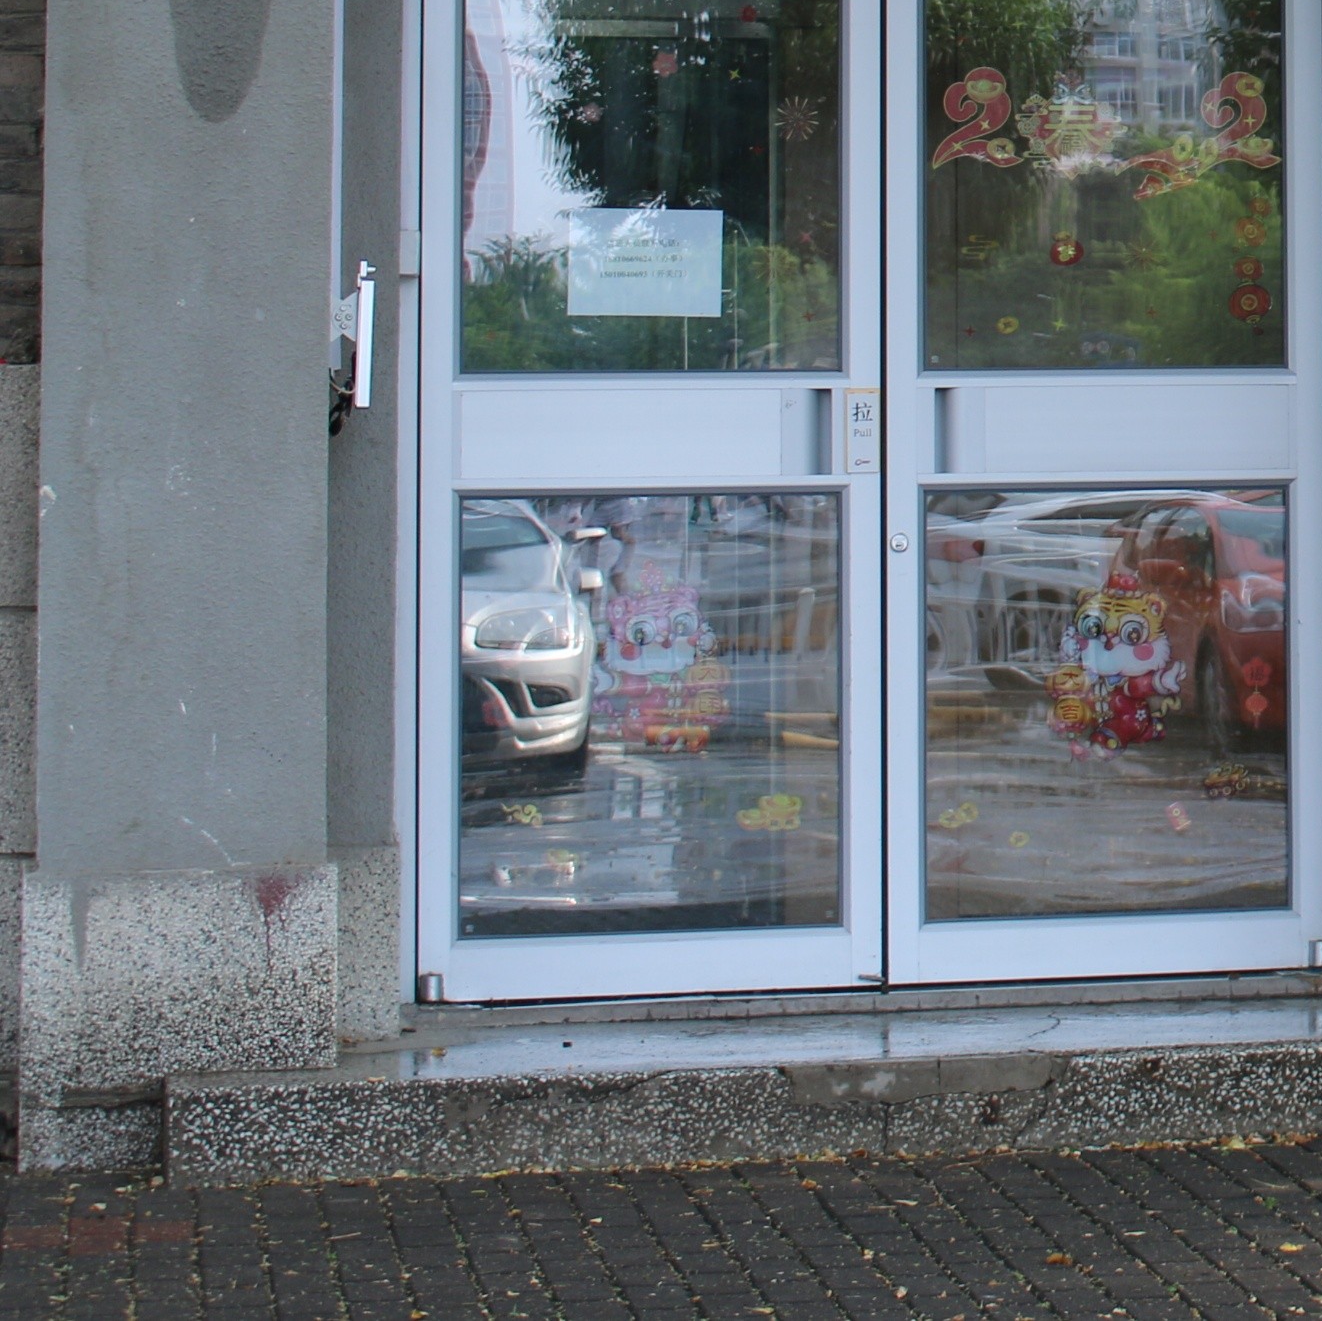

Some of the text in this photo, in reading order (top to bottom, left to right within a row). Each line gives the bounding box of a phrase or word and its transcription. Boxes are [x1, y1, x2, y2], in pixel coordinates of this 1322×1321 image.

[852, 402, 873, 422] 拉
[853, 428, 872, 438] Pull
[1059, 670, 1081, 720] 大吉
